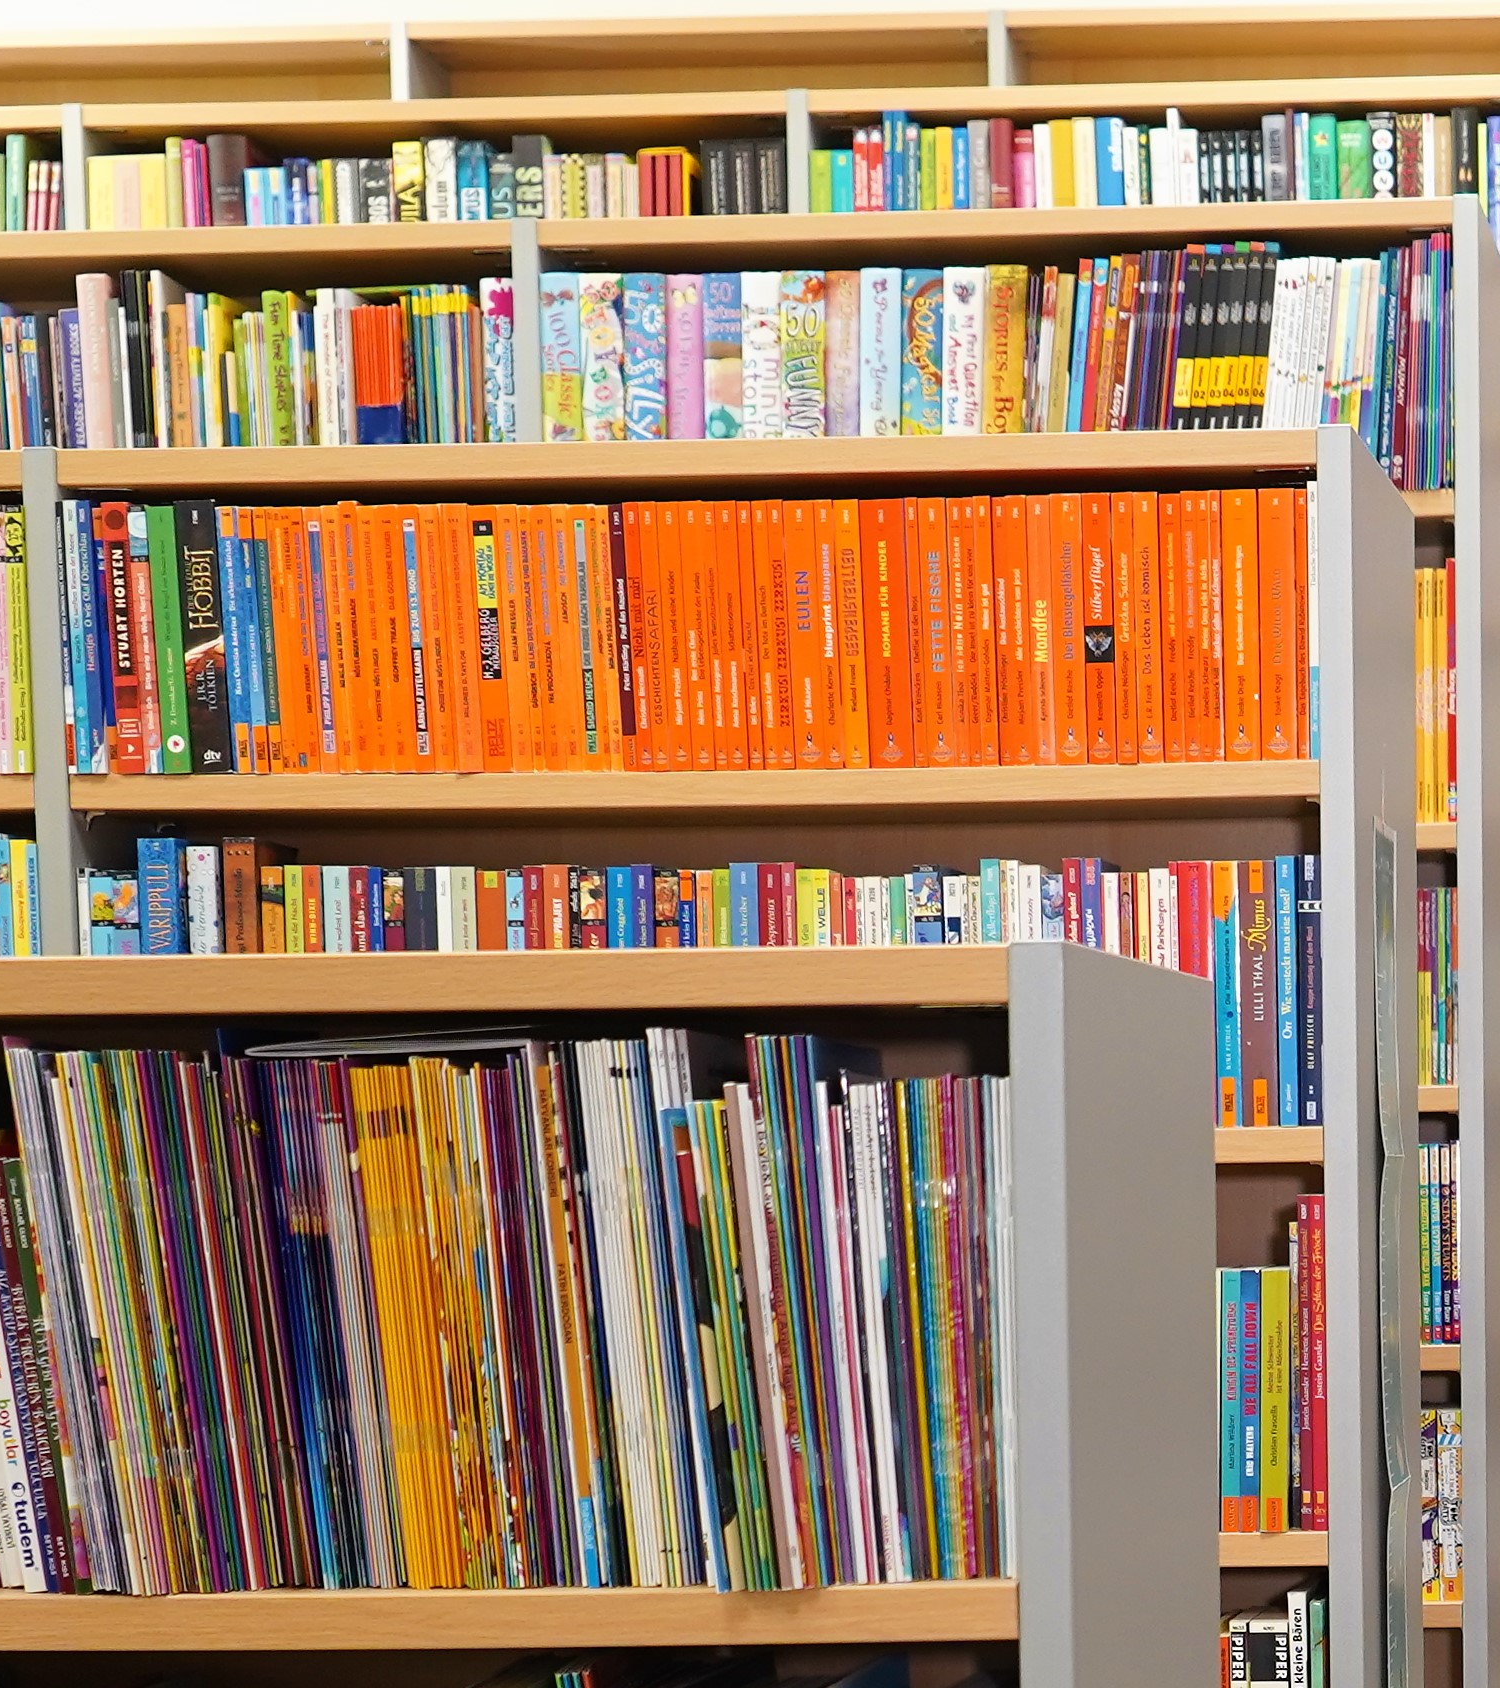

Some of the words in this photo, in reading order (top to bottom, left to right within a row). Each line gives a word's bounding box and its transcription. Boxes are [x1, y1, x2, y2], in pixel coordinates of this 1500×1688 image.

[111, 548, 127, 608] HORTEN
[820, 543, 832, 601] blaupause
[877, 540, 888, 582] KINDER
[183, 545, 219, 630] HOBBIT
[794, 570, 812, 631] EULEN
[878, 585, 889, 607] FÜR
[927, 551, 942, 612] FISCHE
[1060, 540, 1075, 637] Bleisiegelfälscher
[1088, 544, 1105, 620] Silberflügel
[840, 547, 860, 657] GESPENSTERLIED
[116, 614, 131, 668] STUART
[821, 604, 835, 658] blueprint
[879, 610, 892, 658] ROMANE
[930, 619, 945, 672] FETTE
[1031, 600, 1049, 662] Mondfee
[1063, 641, 1075, 660] Der
[205, 658, 218, 712] TOLKIEN
[412, 648, 425, 695] ZITELMANN
[415, 696, 427, 729] ARNULF
[203, 747, 223, 765] dtv
[1279, 888, 1290, 915] Insel?
[1240, 900, 1272, 952] Mimus
[1281, 916, 1290, 934] eine
[1282, 935, 1291, 962] man
[1252, 955, 1263, 988] THAL
[1281, 963, 1291, 995] versteckt
[1254, 993, 1264, 1021] LILLI
[1281, 997, 1291, 1016] Wie
[1283, 1021, 1293, 1040] Orr
[1244, 1303, 1257, 1339] DOWN
[1244, 1341, 1257, 1371] FALL
[1313, 1340, 1324, 1371] Gaarder
[1244, 1372, 1257, 1391] ALL
[1314, 1374, 1325, 1400] Jostein
[1244, 1393, 1257, 1417] WE
[14, 1499, 37, 1569] tudem
[1291, 1608, 1304, 1642] Bären
[1231, 1636, 1245, 1680] PIPER
[1275, 1636, 1288, 1680] PIPER
[1292, 1646, 1304, 1683] kleine
